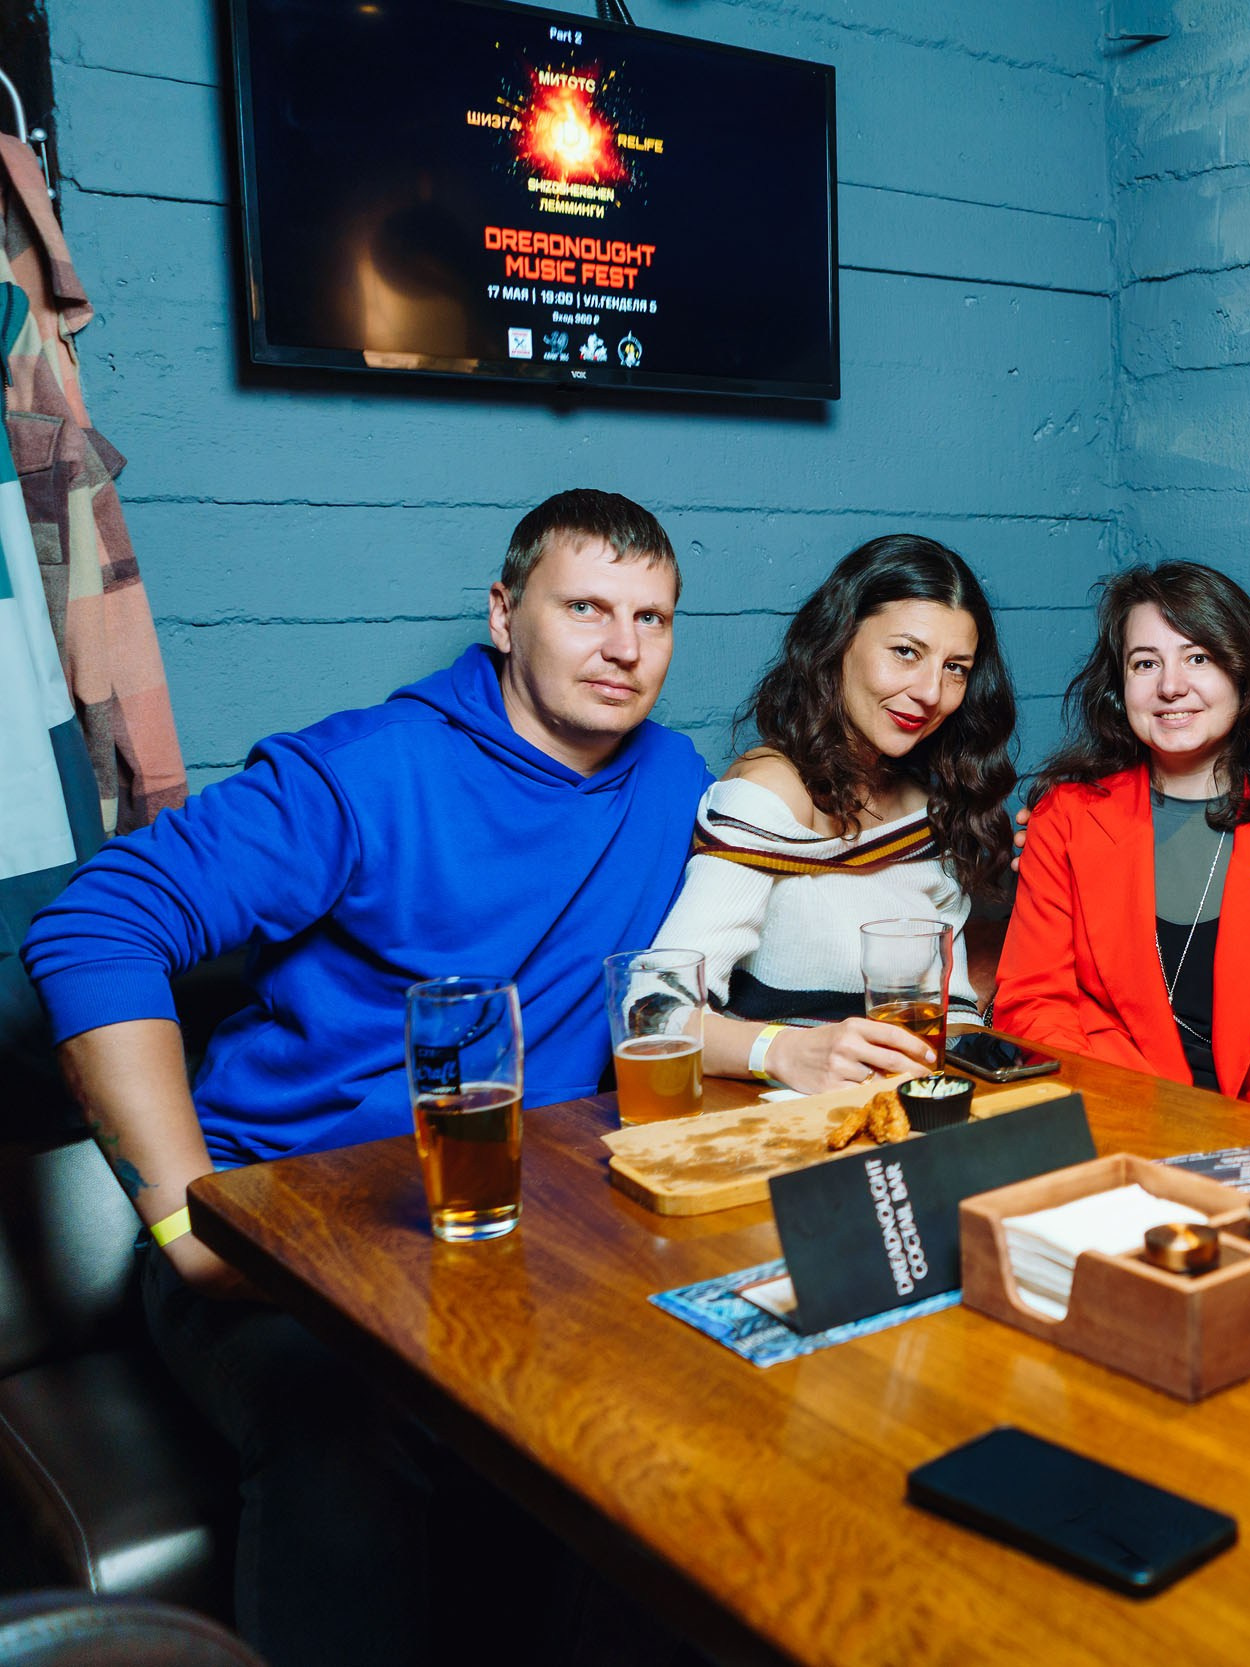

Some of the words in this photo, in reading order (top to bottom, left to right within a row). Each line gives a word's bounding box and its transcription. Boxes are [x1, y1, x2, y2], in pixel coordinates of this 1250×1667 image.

[550, 26, 572, 44] Part
[574, 31, 583, 46] 2
[467, 110, 521, 132] ШИЗГА
[618, 133, 664, 154] RELIFE
[539, 197, 605, 219] ЛЕММИНГИ
[484, 226, 656, 267] DREADNOUGHT
[505, 254, 576, 284] MUSIC
[581, 263, 639, 290] FEST
[487, 285, 500, 298] 17
[502, 286, 529, 301] МАЯ
[552, 311, 574, 325] Вход
[885, 1162, 908, 1202] BAR
[865, 1159, 914, 1296] DREADNOUGHT
